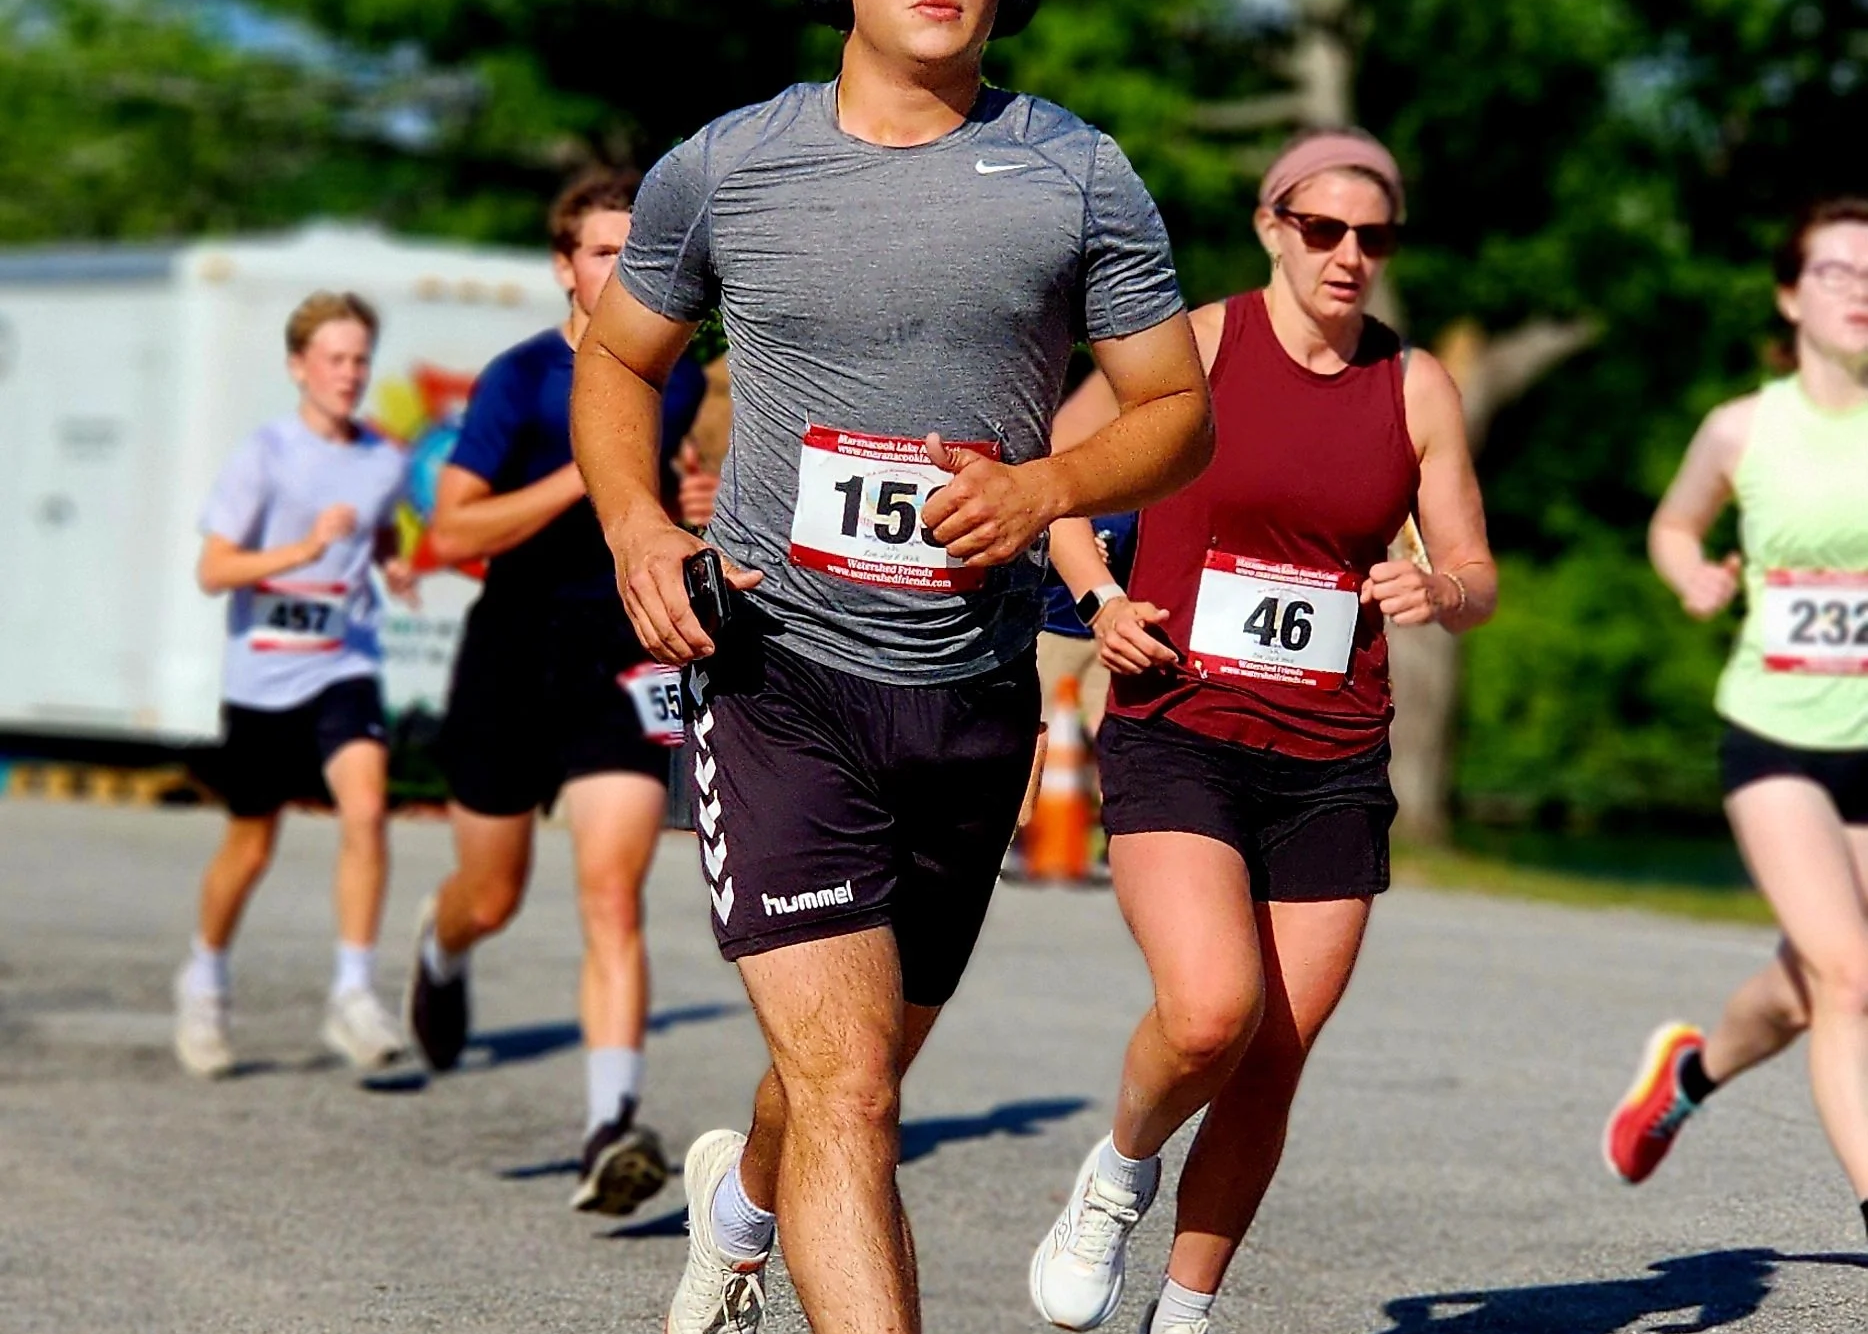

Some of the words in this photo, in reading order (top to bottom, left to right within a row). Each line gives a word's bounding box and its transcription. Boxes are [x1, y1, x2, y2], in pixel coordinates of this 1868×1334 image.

[896, 442, 918, 453] Lake
[898, 565, 933, 577] Friends
[1243, 597, 1314, 651] 46
[1788, 598, 1868, 646] 232
[761, 880, 854, 916] hummel
